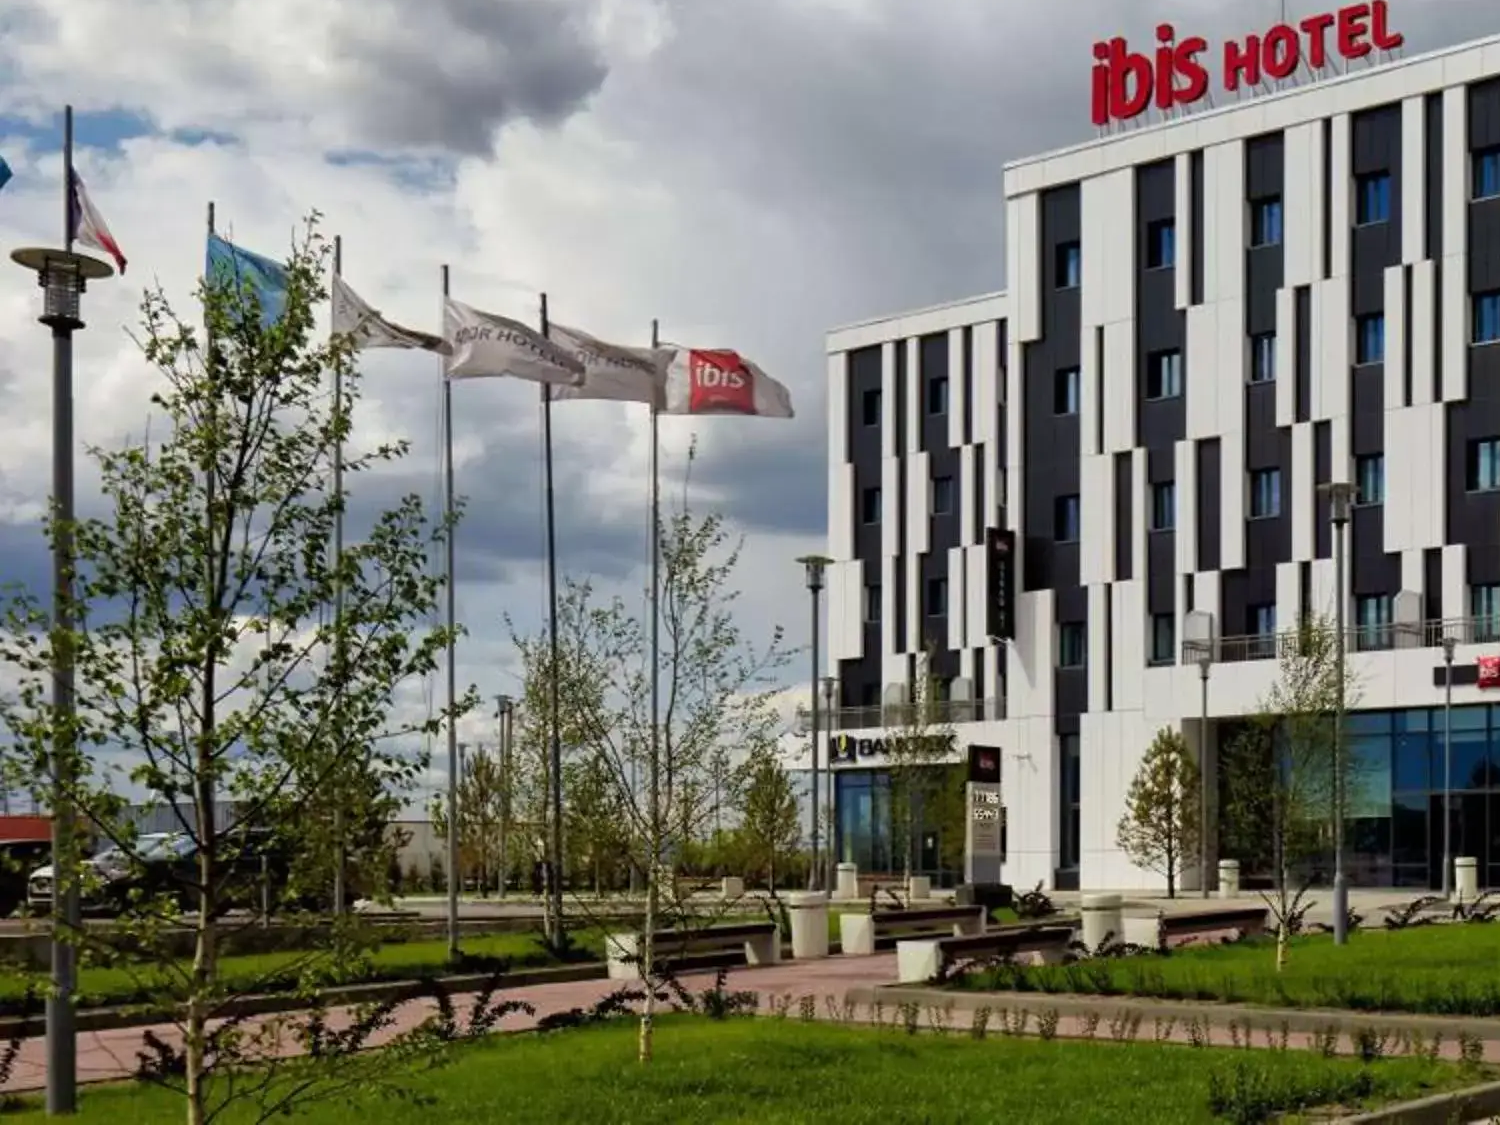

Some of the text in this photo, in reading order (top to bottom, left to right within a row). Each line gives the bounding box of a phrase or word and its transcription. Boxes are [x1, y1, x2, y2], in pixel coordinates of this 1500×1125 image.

[1092, 0, 1404, 125] ibis HOTEL
[696, 361, 745, 388] ibis
